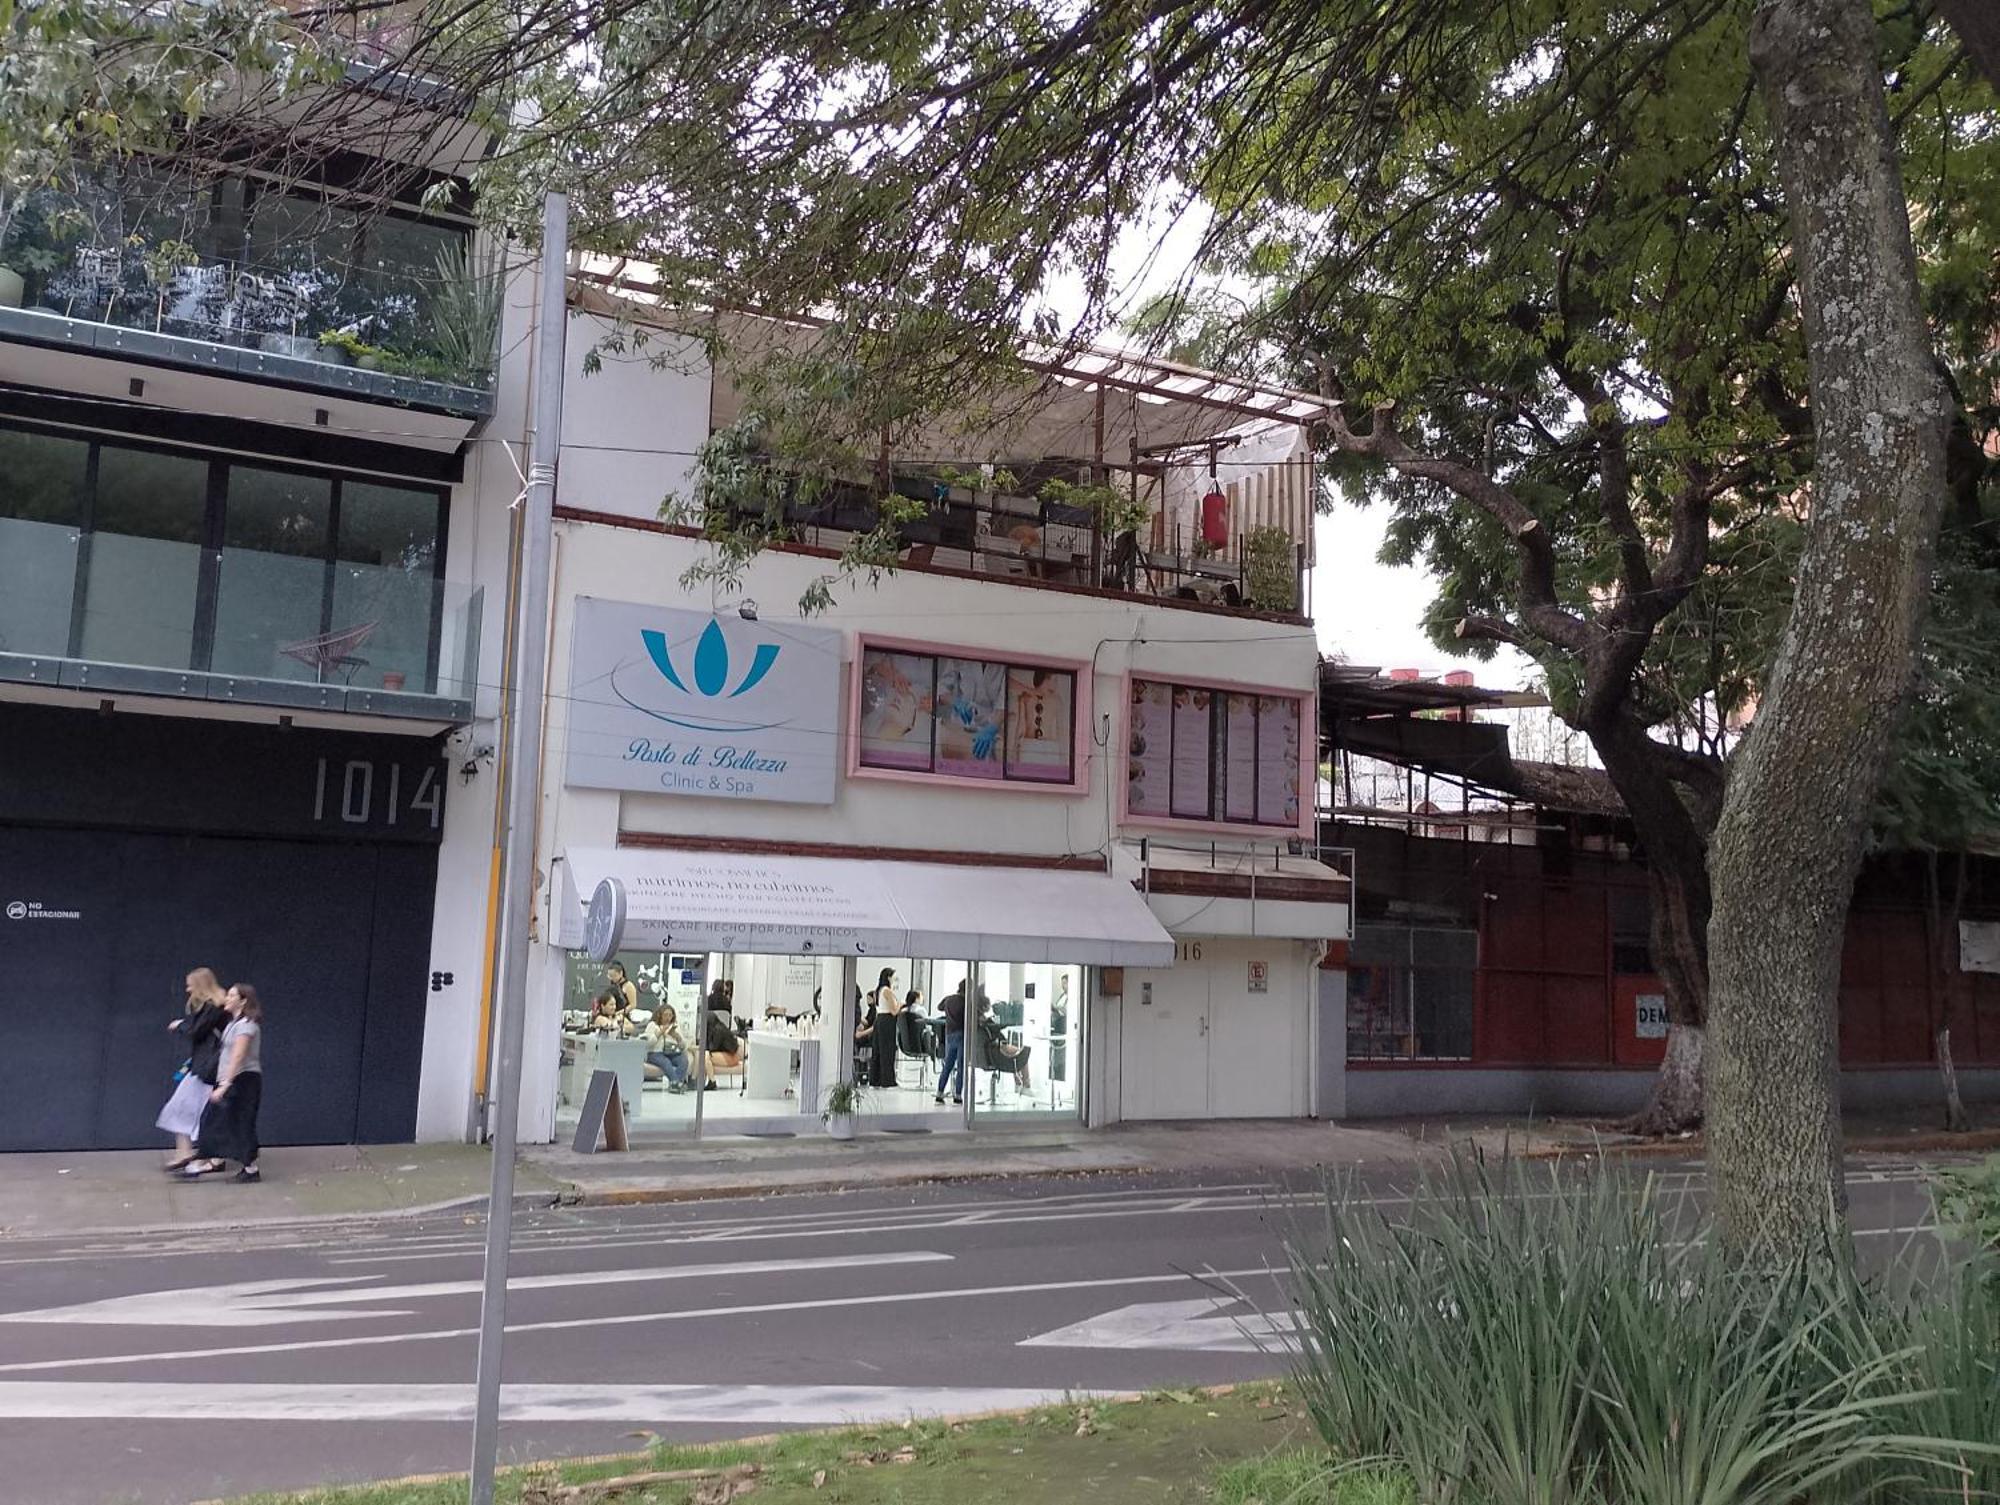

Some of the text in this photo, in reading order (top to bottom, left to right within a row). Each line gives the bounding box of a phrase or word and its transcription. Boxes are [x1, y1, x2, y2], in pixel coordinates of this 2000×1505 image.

[623, 738, 787, 773] Pasto di Bellezza
[314, 758, 440, 828] 1014
[661, 771, 754, 796] Clinic & Spa
[28, 910, 80, 919] ESTACIONAR
[706, 922, 747, 933] HECHO
[750, 924, 774, 935] POR
